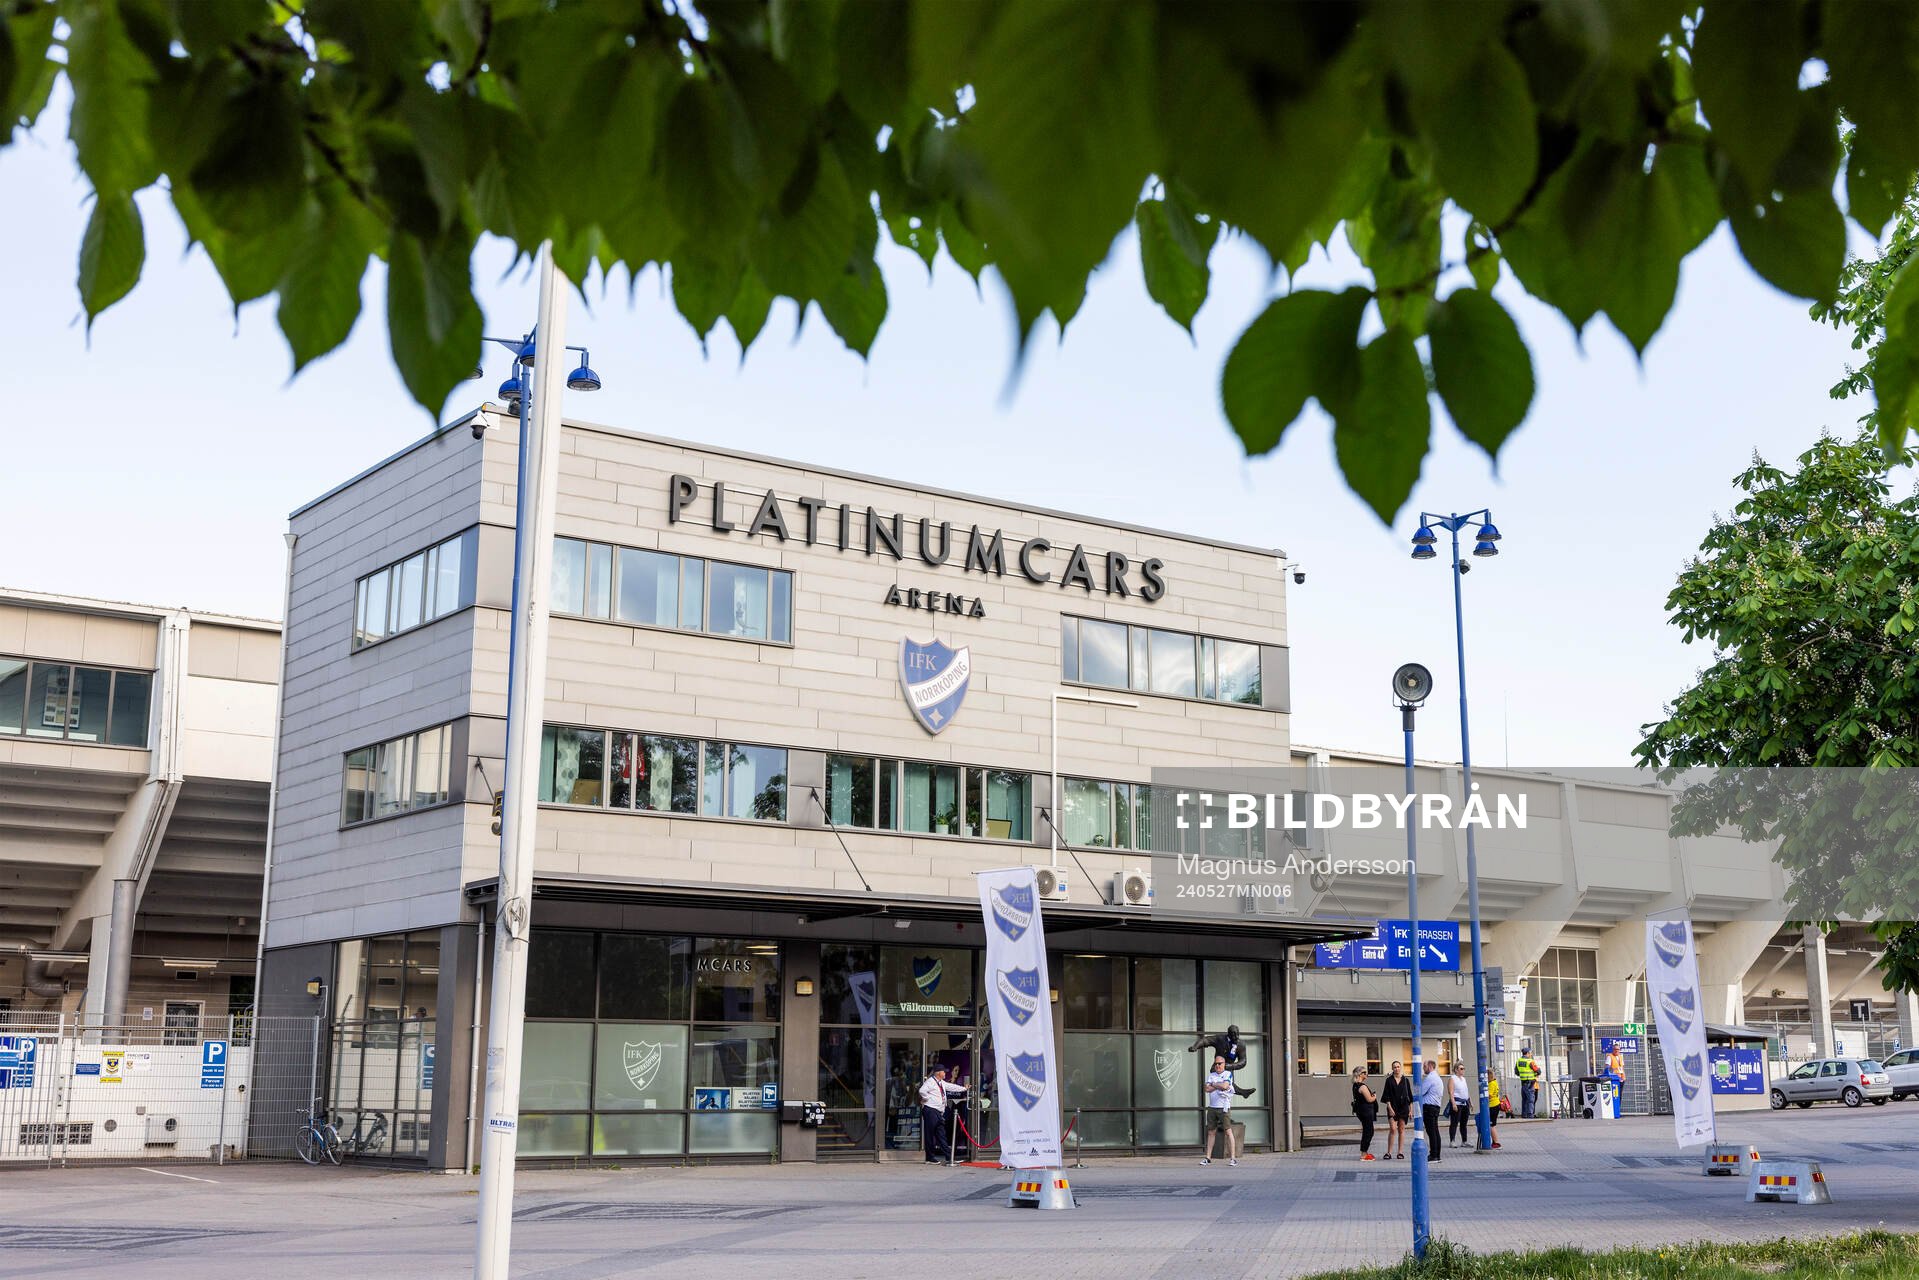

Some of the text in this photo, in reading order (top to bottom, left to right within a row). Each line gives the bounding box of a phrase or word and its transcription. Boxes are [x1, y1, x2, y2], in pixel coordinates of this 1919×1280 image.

[669, 474, 1166, 602] PLATINUMCARS
[884, 583, 986, 618] ARENA
[909, 652, 937, 671] IFK
[914, 661, 968, 703] NORRKÖPING
[1394, 929, 1453, 940] IFK RRASSEN
[1398, 945, 1426, 958] Ené
[900, 1002, 955, 1013] Välkommen
[1853, 1003, 1865, 1018] T
[208, 1043, 223, 1063] P
[628, 1049, 643, 1059] IFK
